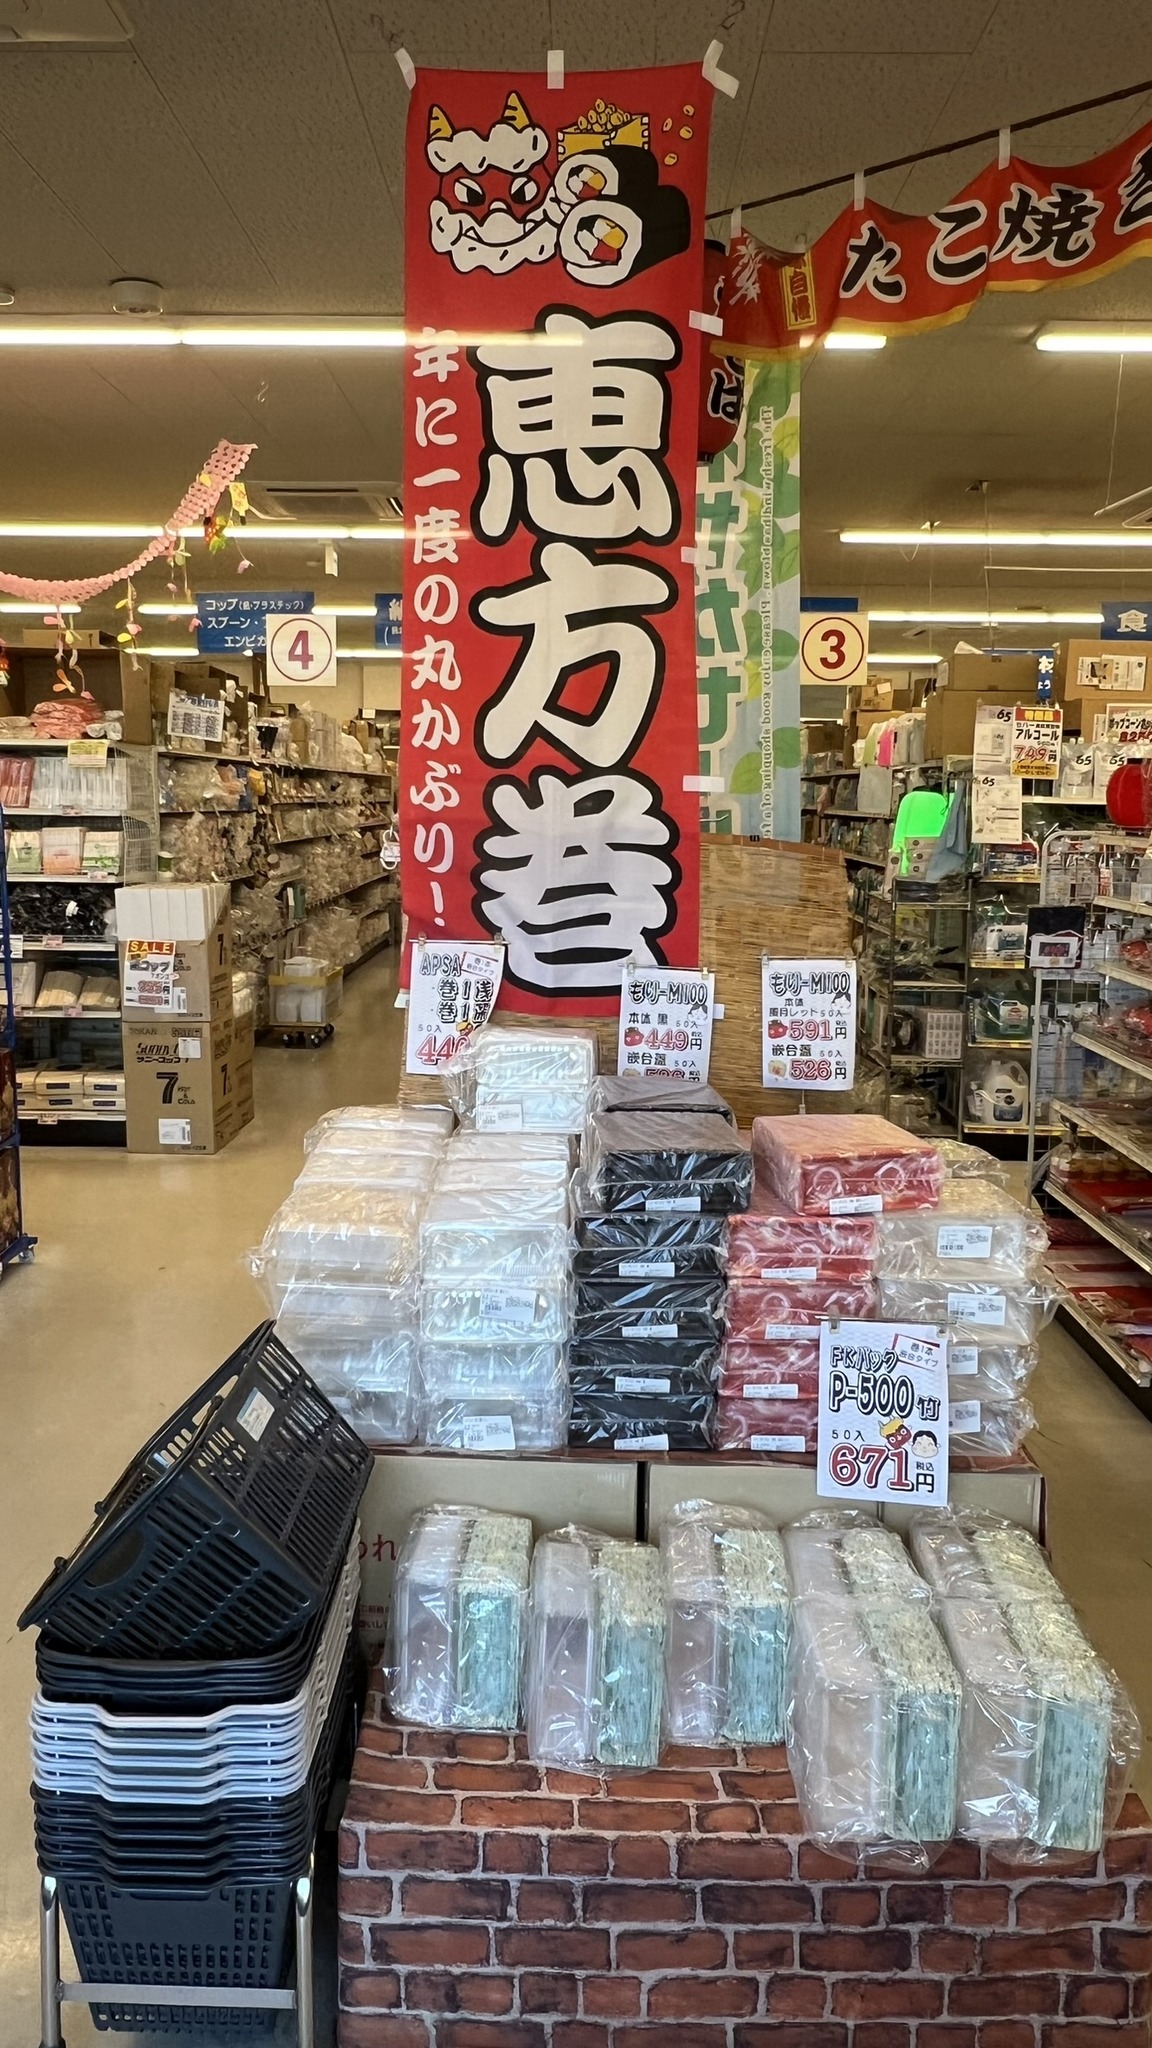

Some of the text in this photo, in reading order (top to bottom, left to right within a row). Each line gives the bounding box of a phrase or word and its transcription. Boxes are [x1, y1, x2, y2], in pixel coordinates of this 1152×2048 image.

[207, 616, 267, 629] スプーン・
[288, 630, 314, 670] 4
[469, 312, 682, 993] 恵方巻
[819, 629, 847, 670] 3
[1015, 729, 1060, 741] アルコール
[130, 941, 171, 953] SALE
[419, 952, 462, 976] APSA
[644, 1028, 689, 1051] 449
[690, 1038, 702, 1051] 円
[789, 1019, 833, 1041] 591
[835, 1026, 847, 1040] 円
[790, 1058, 832, 1080] 526
[835, 1066, 847, 1080] 円
[156, 1072, 179, 1105] 7
[830, 1344, 900, 1374] FKパック
[828, 1371, 942, 1422] P-500 竹
[832, 1430, 865, 1442] 50入
[828, 1442, 935, 1493] 671 税込 円
